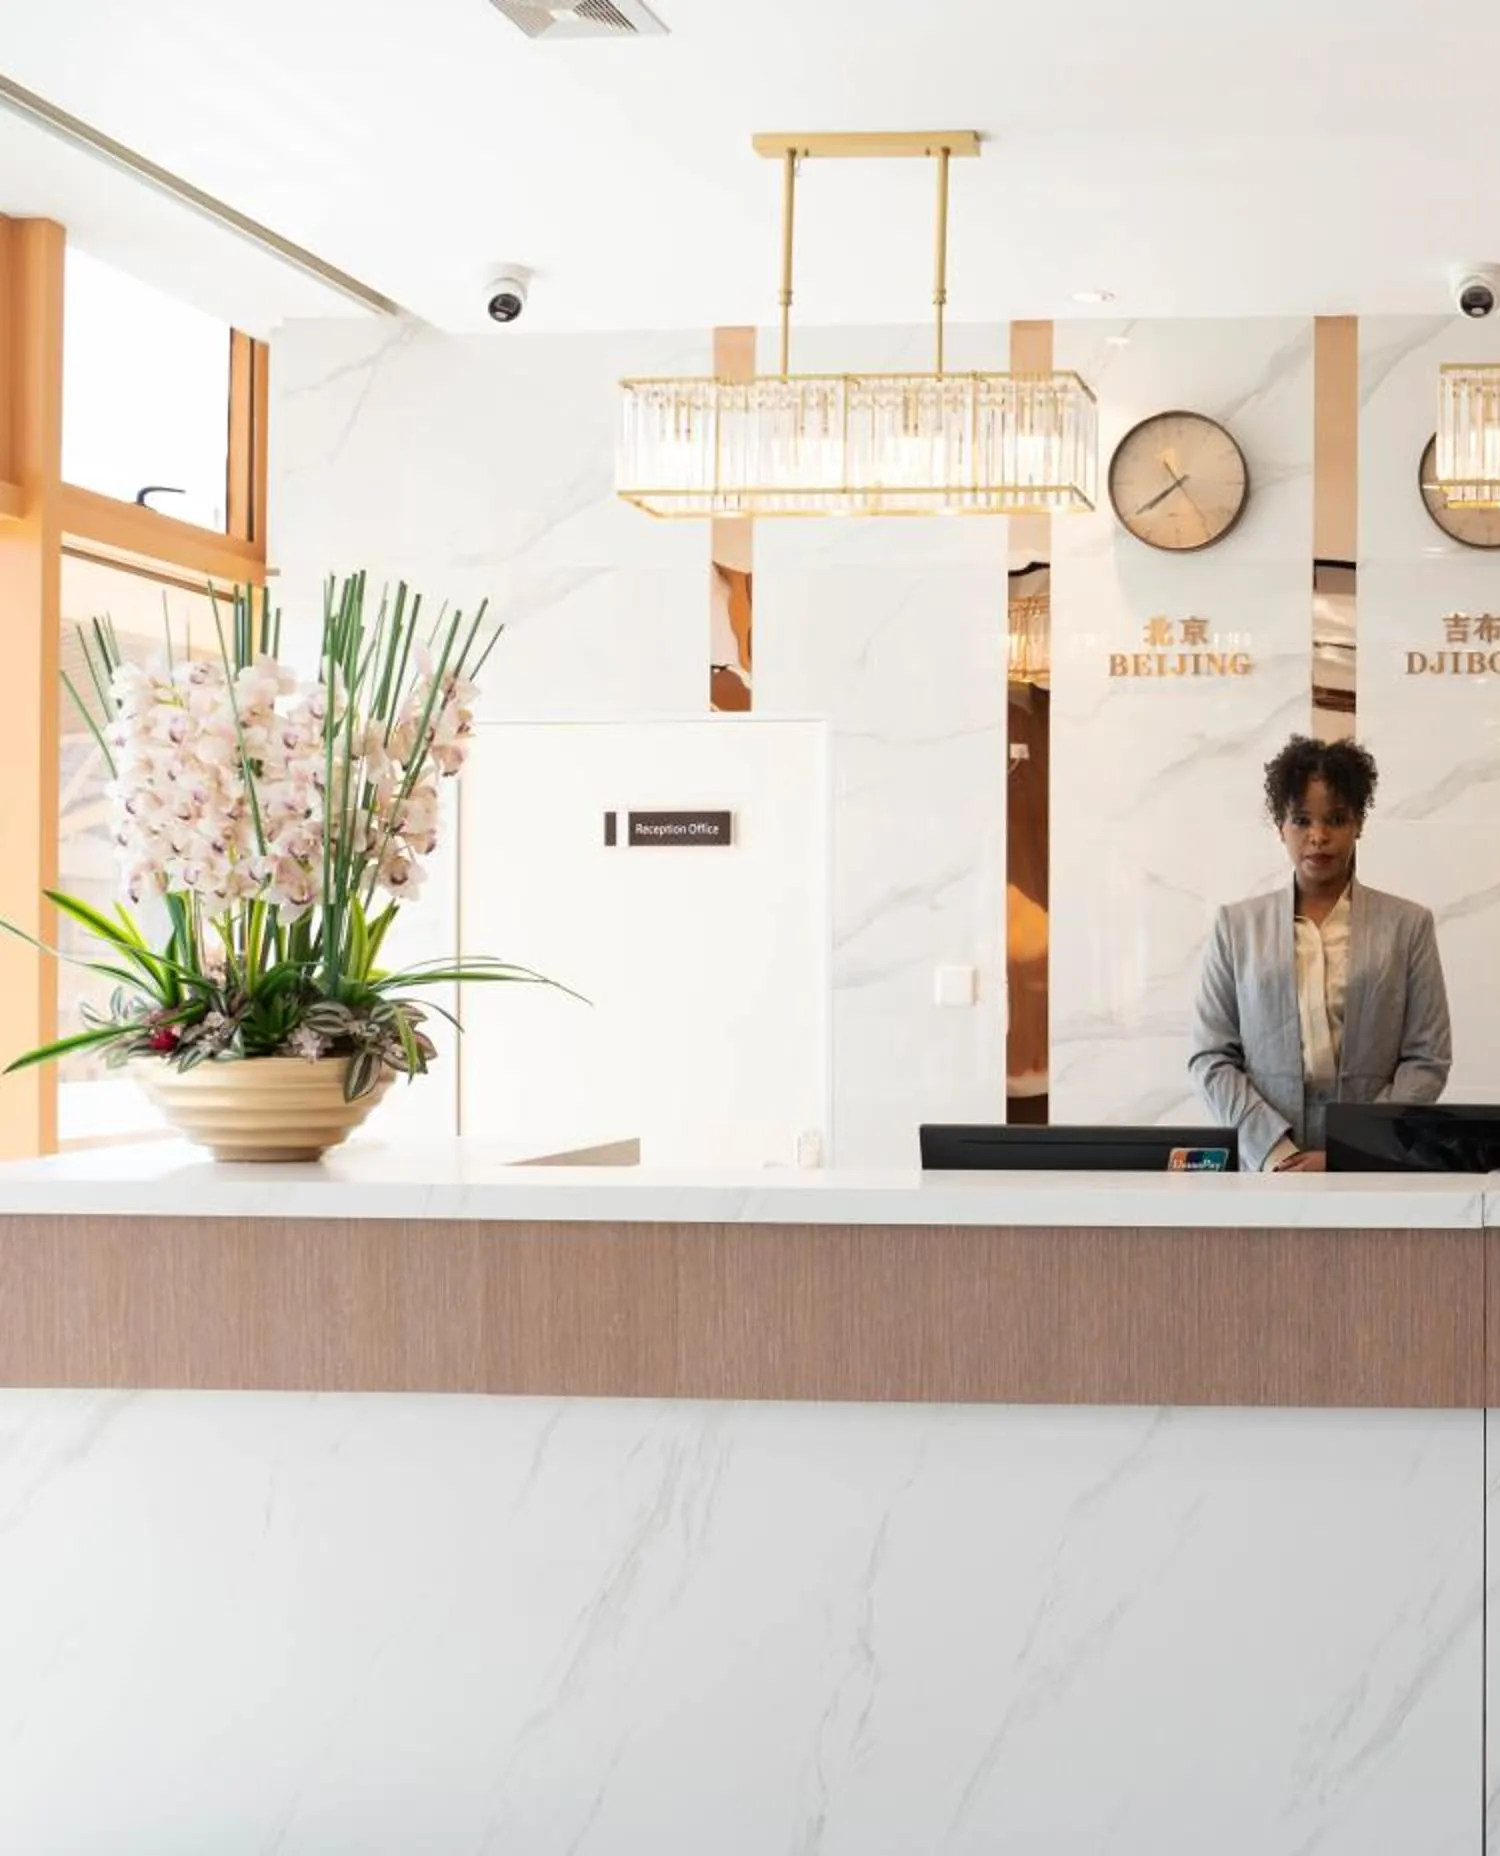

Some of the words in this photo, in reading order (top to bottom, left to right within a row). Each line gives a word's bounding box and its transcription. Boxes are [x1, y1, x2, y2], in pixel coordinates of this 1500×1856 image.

[1143, 616, 1210, 646] 北京
[1108, 652, 1252, 677] BEIJING
[635, 823, 687, 836] Reception
[688, 823, 720, 835] Office
